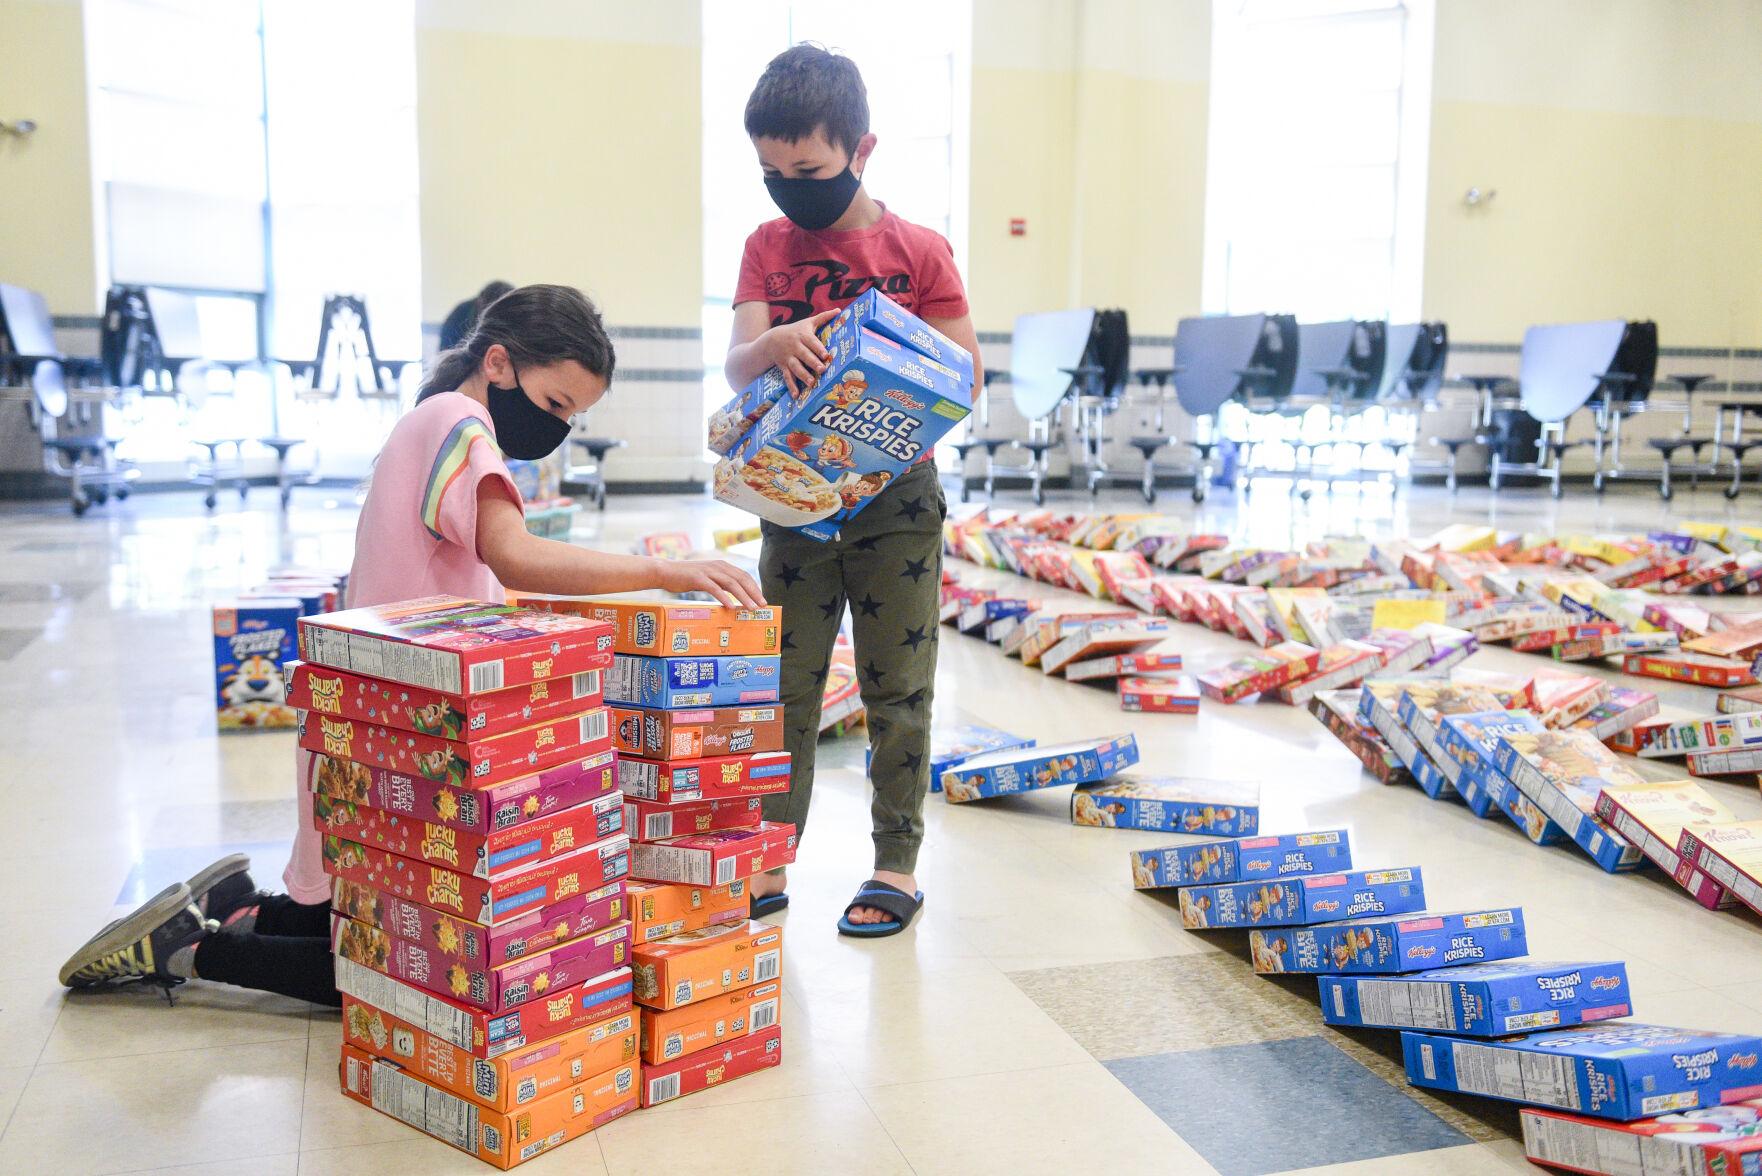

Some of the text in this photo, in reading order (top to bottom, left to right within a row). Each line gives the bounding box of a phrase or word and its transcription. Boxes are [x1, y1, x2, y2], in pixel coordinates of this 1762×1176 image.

[790, 259, 912, 304] Pizza
[910, 333, 941, 359] KRISPIES
[917, 329, 935, 344] RICE
[899, 365, 934, 389] KRISPIES
[906, 361, 926, 376] RICE
[884, 389, 925, 410] Kellogg's
[854, 398, 922, 438] RICE
[811, 404, 920, 461] KRISPIES
[636, 613, 645, 645] Wheats
[729, 735, 754, 745] FROSTED
[1484, 723, 1528, 737] RICE
[730, 742, 752, 752] FLAKES
[391, 775, 401, 809] BITE
[460, 794, 468, 821] Bran
[466, 794, 475, 827] Raisin
[496, 805, 520, 820] Raisin
[1139, 801, 1149, 827] BITE
[496, 815, 517, 829] Bran
[425, 822, 456, 849] Lucky
[421, 839, 459, 867] Charms
[1247, 859, 1272, 871] Kellogg's
[1285, 853, 1306, 864] RICE
[1164, 851, 1173, 882] BITE
[1278, 861, 1313, 875] KRISPIES
[430, 867, 460, 895] Lucky
[426, 884, 463, 912] Charms
[1218, 889, 1228, 922] BITE
[1313, 899, 1340, 912] Kellogg's
[1347, 901, 1385, 916] KRISPIES
[1353, 892, 1375, 904] RICE
[401, 904, 411, 937] BITE
[408, 907, 417, 940] EVERY
[506, 940, 527, 952] Raisin
[507, 948, 525, 960] Bran
[1296, 931, 1308, 968] BITE
[1303, 931, 1312, 968] EVERY
[1375, 929, 1384, 964] KRISPIES
[1407, 946, 1436, 958] Kellogg's
[1443, 947, 1485, 963] KRISPIES
[1451, 936, 1474, 949] RICE
[408, 946, 417, 979] BITE
[415, 949, 424, 983] EVERY
[476, 972, 485, 1003] Raisin
[504, 984, 529, 999] Raisin
[1536, 971, 1582, 991] KRISPIES
[1551, 987, 1576, 1000] RICE
[1590, 976, 1621, 990] Kellogg's
[505, 993, 528, 1008] Bran
[1458, 983, 1472, 1030] KRISPIES
[1467, 994, 1476, 1020] RICE
[428, 1036, 439, 1077] BITE
[438, 1038, 448, 1082] EVERY
[1673, 1048, 1719, 1069] KRISPIES
[476, 1060, 485, 1095] Wheats
[483, 1065, 491, 1096] Mini
[1584, 1059, 1601, 1111] KRISPIES
[1686, 1067, 1711, 1081] RICE
[1596, 1072, 1608, 1103] RICE
